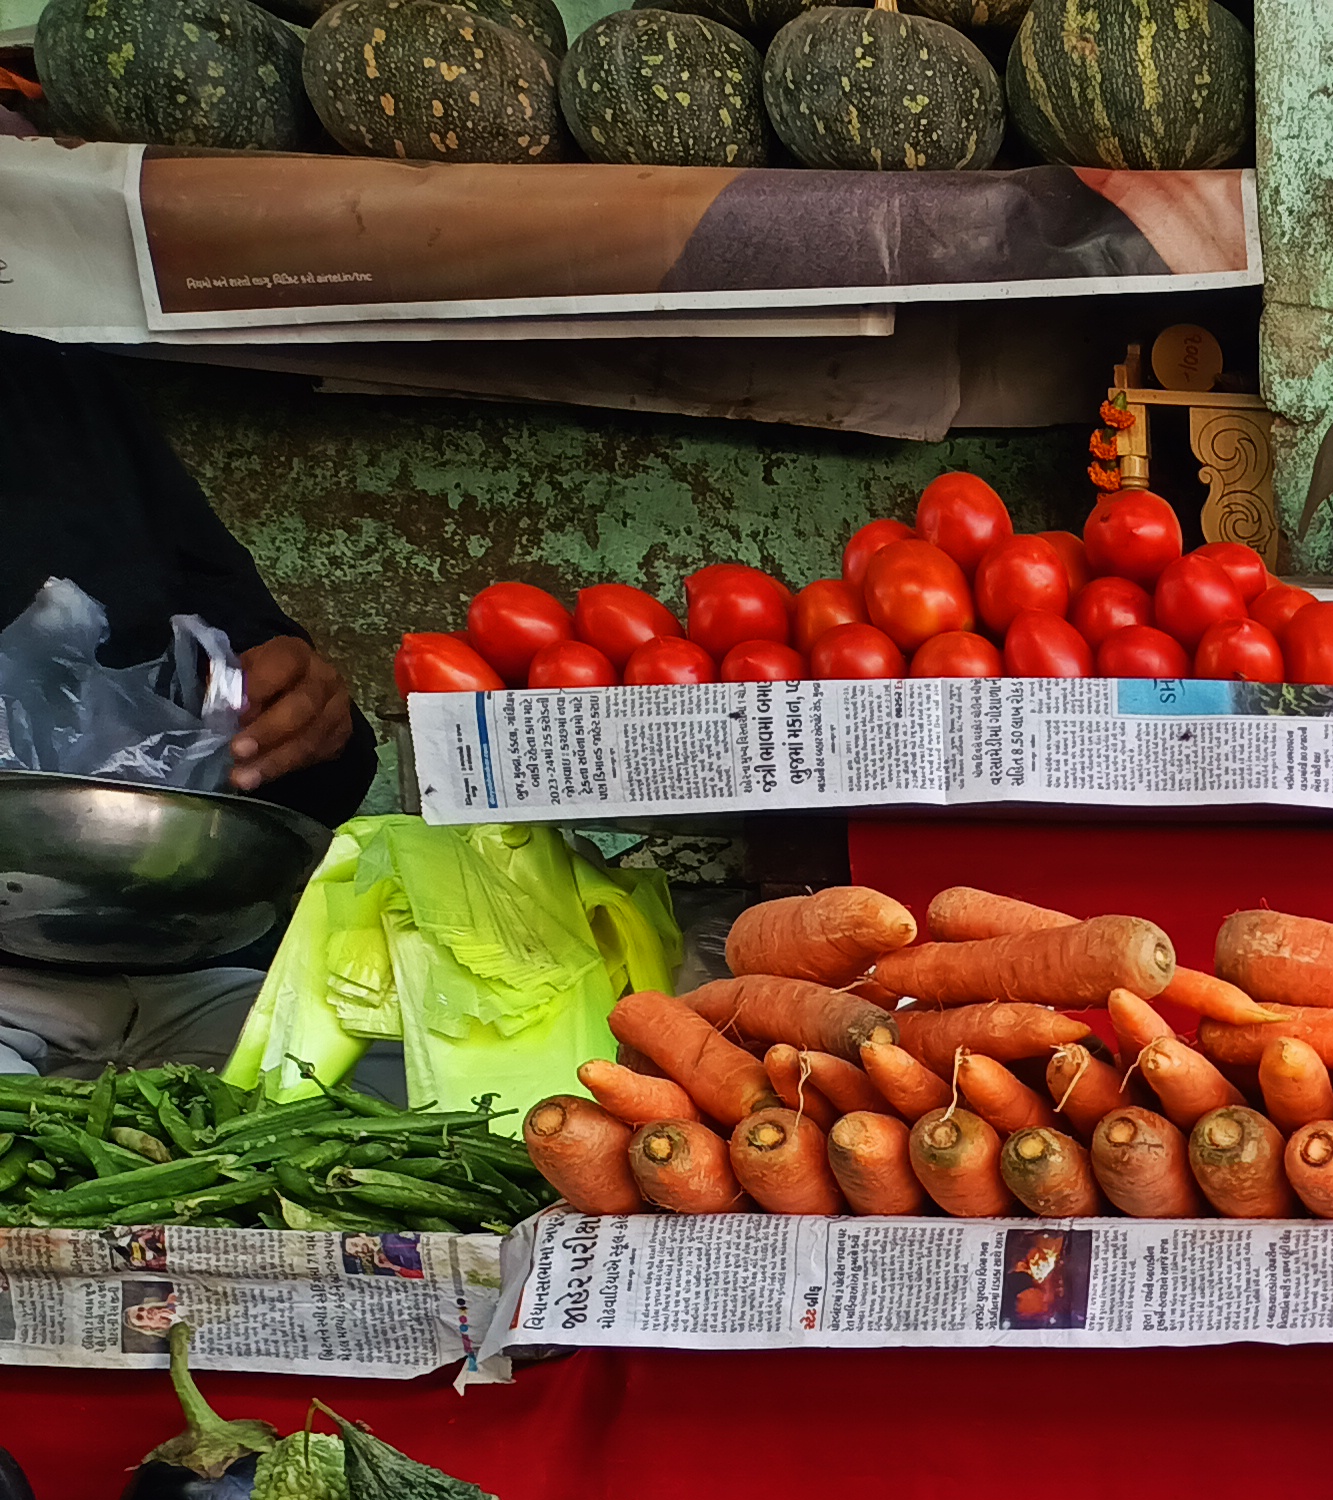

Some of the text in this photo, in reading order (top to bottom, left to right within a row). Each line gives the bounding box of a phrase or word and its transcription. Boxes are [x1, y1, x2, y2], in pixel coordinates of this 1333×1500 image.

[1011, 706, 1023, 729] લાખ
[543, 734, 553, 747] 25
[752, 716, 774, 761] ભાવમાં
[782, 696, 812, 784] ભુજમાં મકાન,
[1006, 757, 1024, 786] સહિત
[554, 1276, 592, 1329] જાહેર
